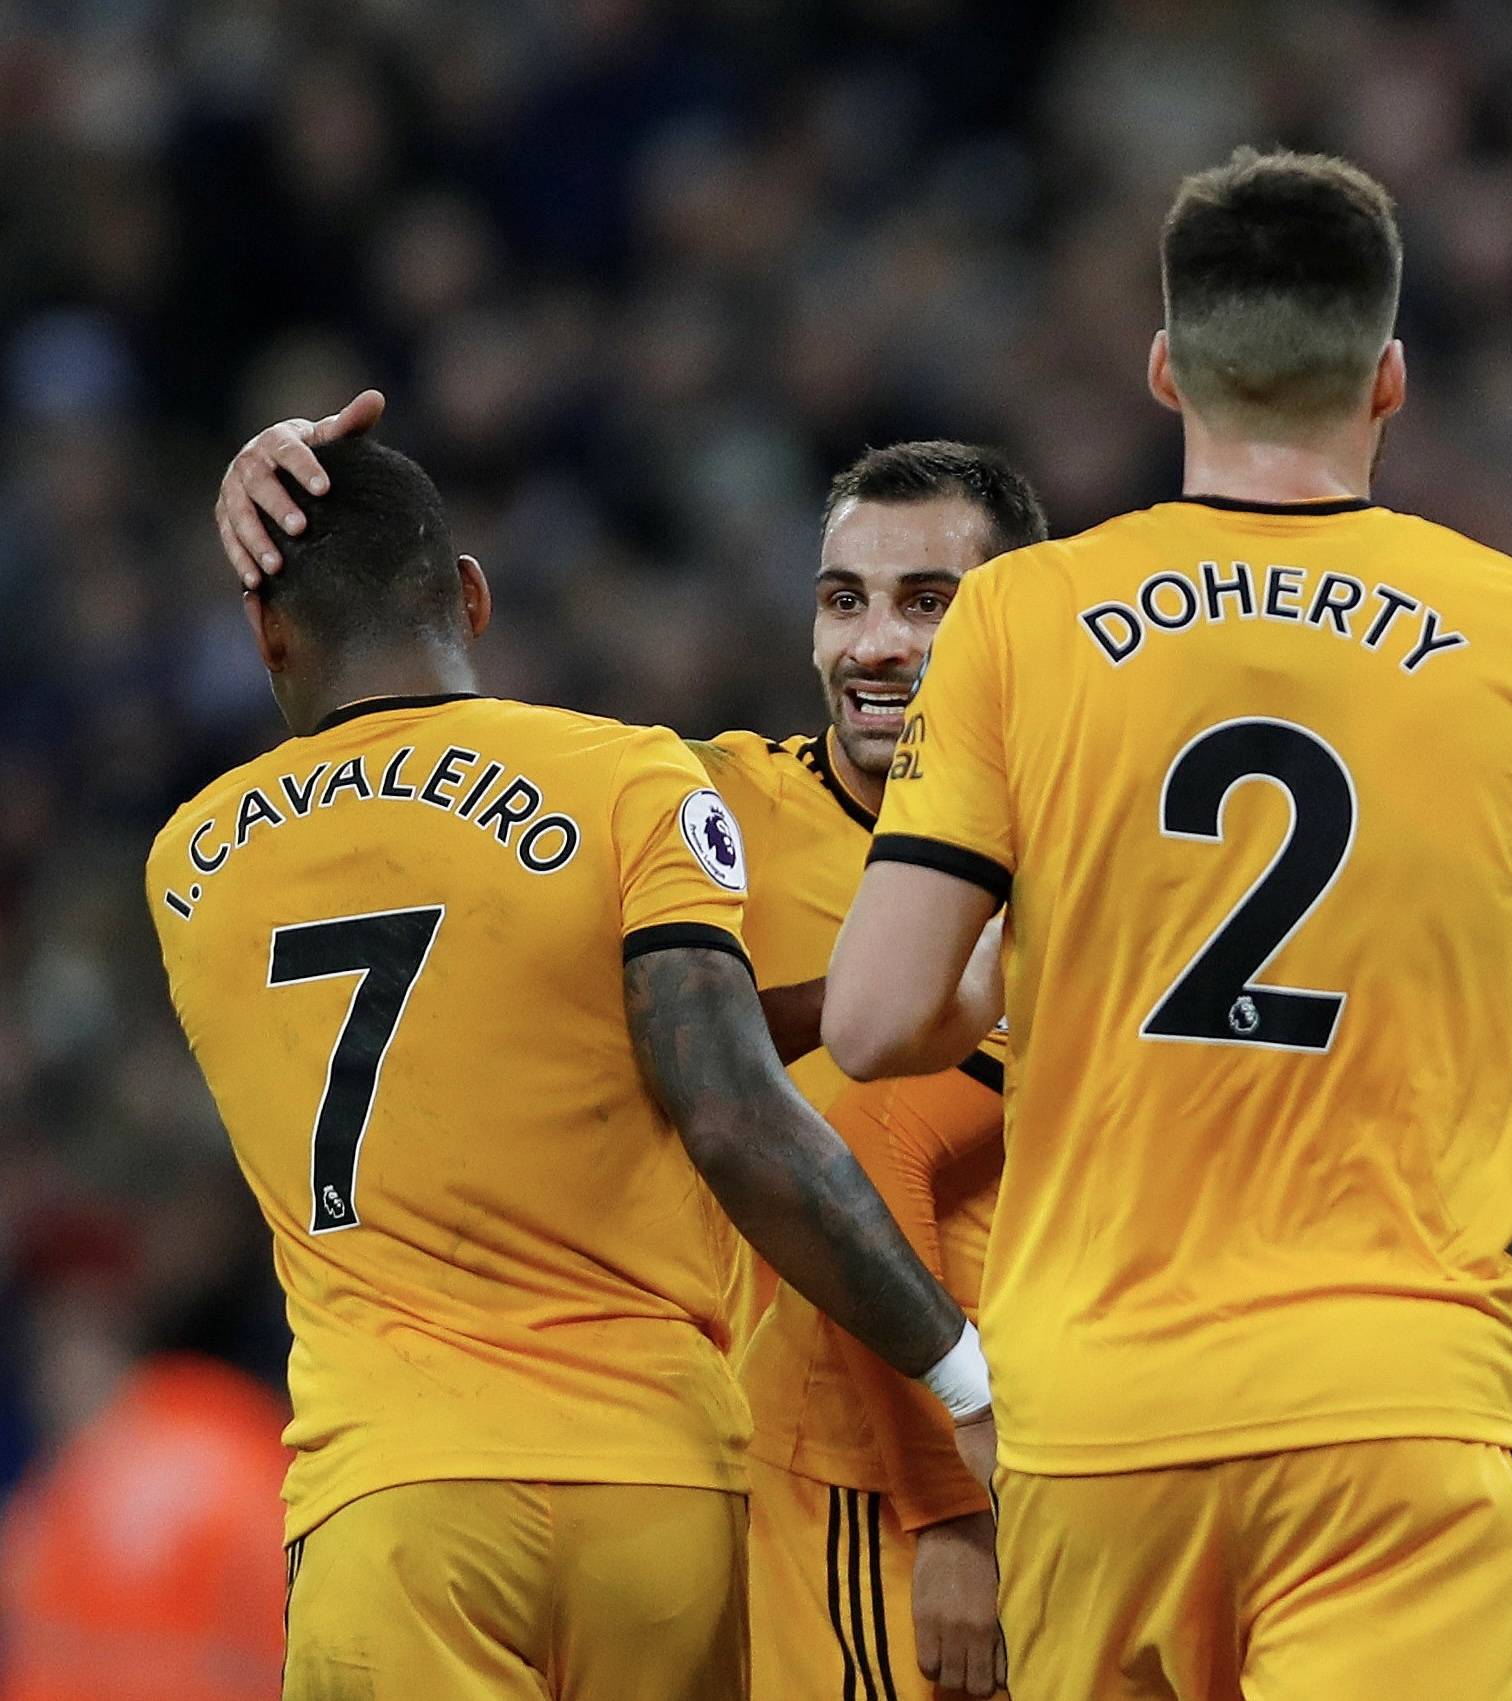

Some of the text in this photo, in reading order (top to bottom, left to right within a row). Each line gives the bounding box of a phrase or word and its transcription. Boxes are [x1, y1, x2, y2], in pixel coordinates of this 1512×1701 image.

[1078, 561, 1469, 676] DOHERTY
[187, 746, 581, 875] CAVALEIRO
[1139, 715, 1359, 1054] 2
[266, 904, 446, 1236] 7
